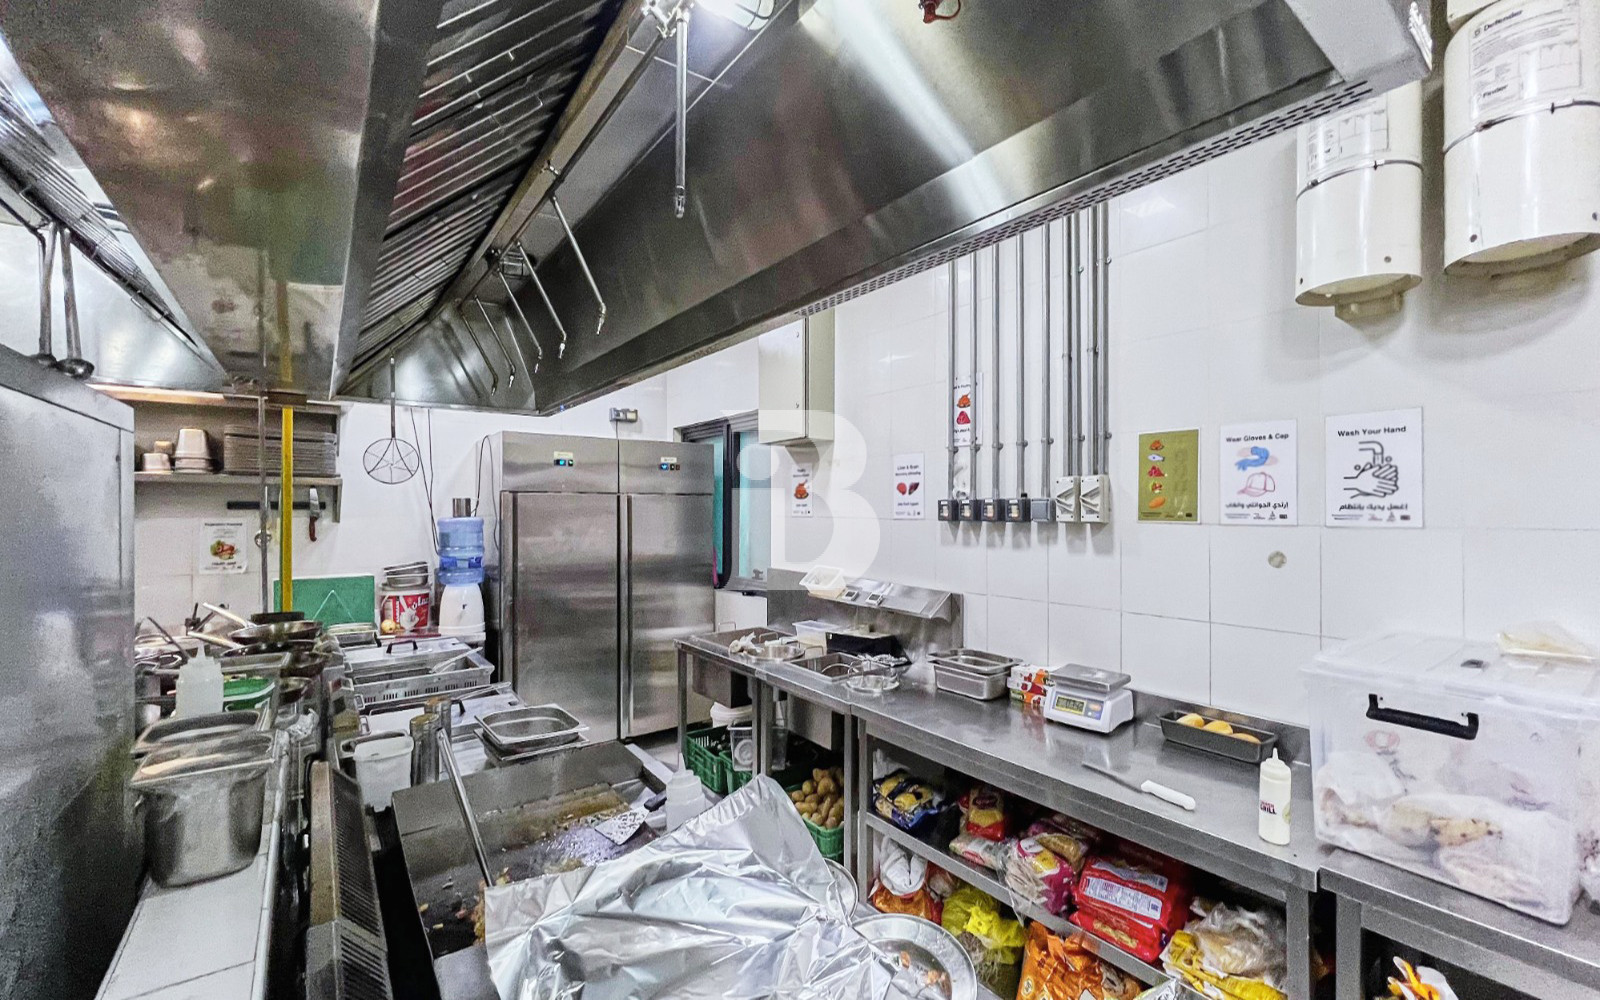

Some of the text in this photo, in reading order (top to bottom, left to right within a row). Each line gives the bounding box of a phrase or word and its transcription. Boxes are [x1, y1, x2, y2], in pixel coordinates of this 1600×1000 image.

[1337, 429, 1360, 437] Wash
[1383, 425, 1407, 433] Hand
[1243, 434, 1267, 442] Gloves
[1275, 432, 1290, 440] Cap
